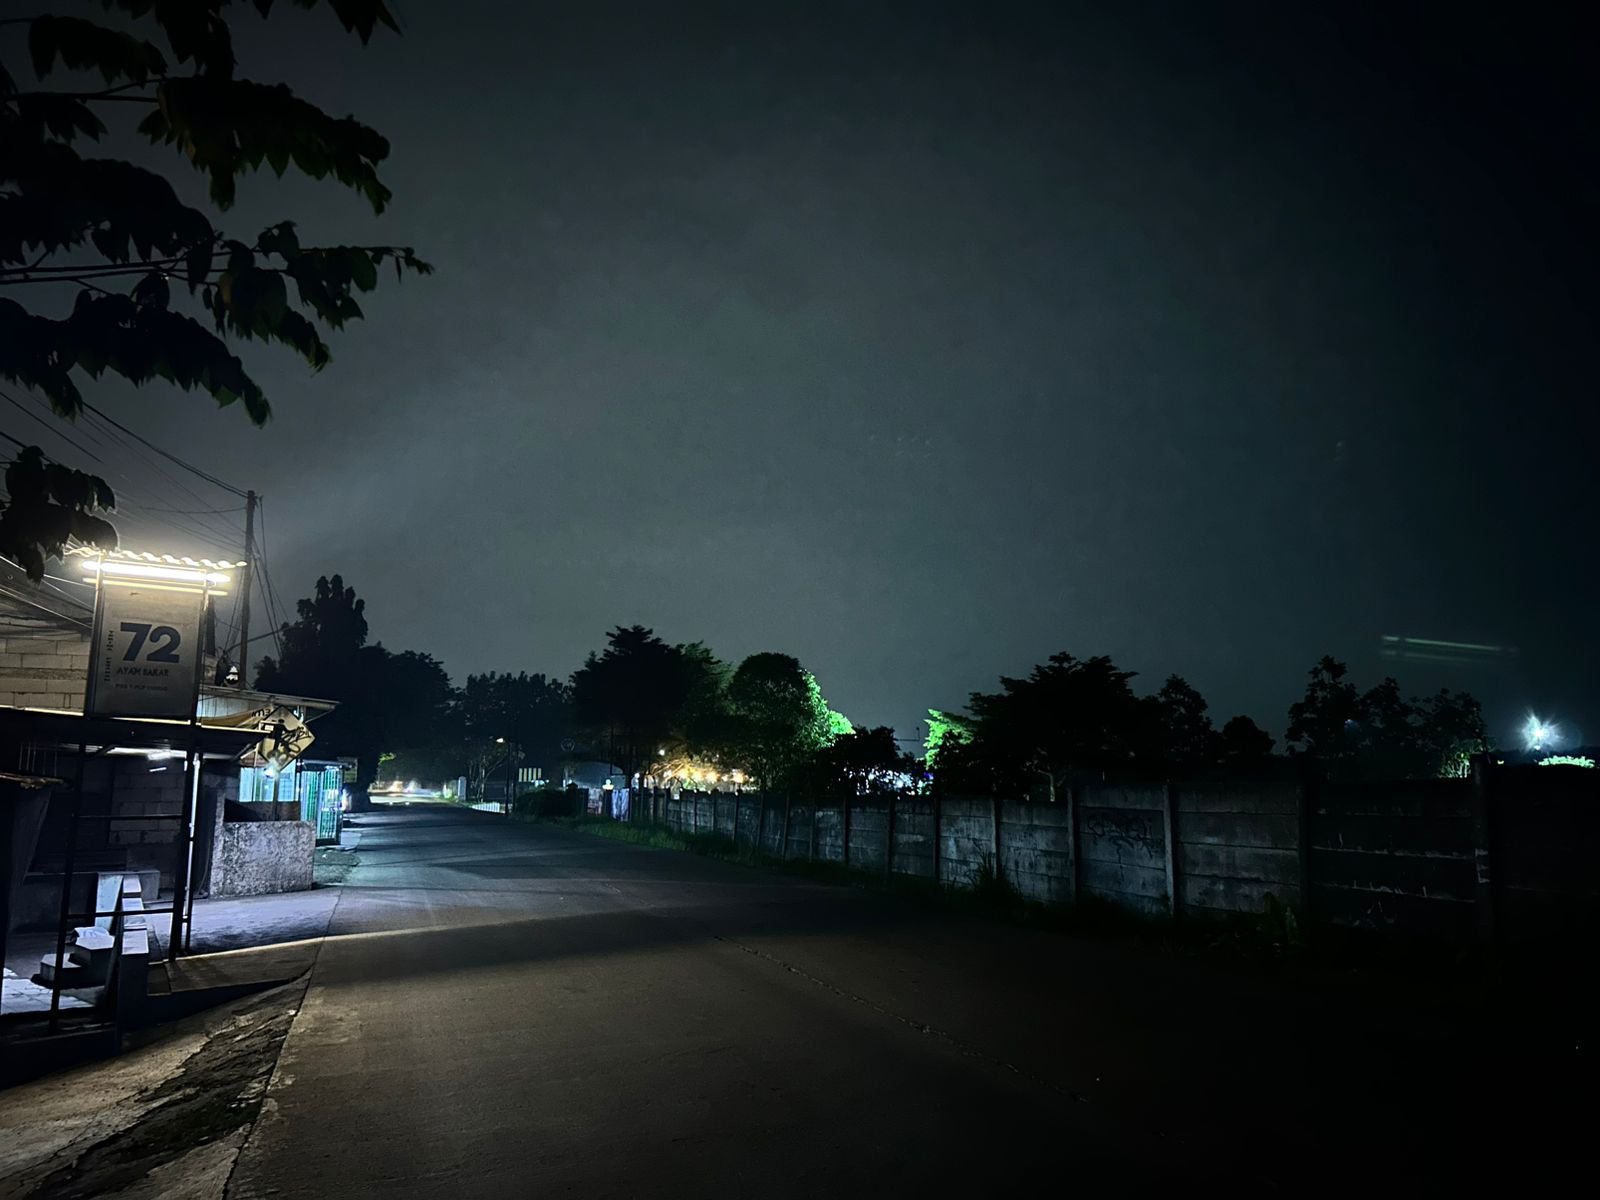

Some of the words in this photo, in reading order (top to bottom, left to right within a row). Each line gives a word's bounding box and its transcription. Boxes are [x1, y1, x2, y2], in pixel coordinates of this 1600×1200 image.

[120, 622, 181, 663] 72
[116, 666, 141, 676] AYAM
[143, 667, 169, 677] BAKAR
